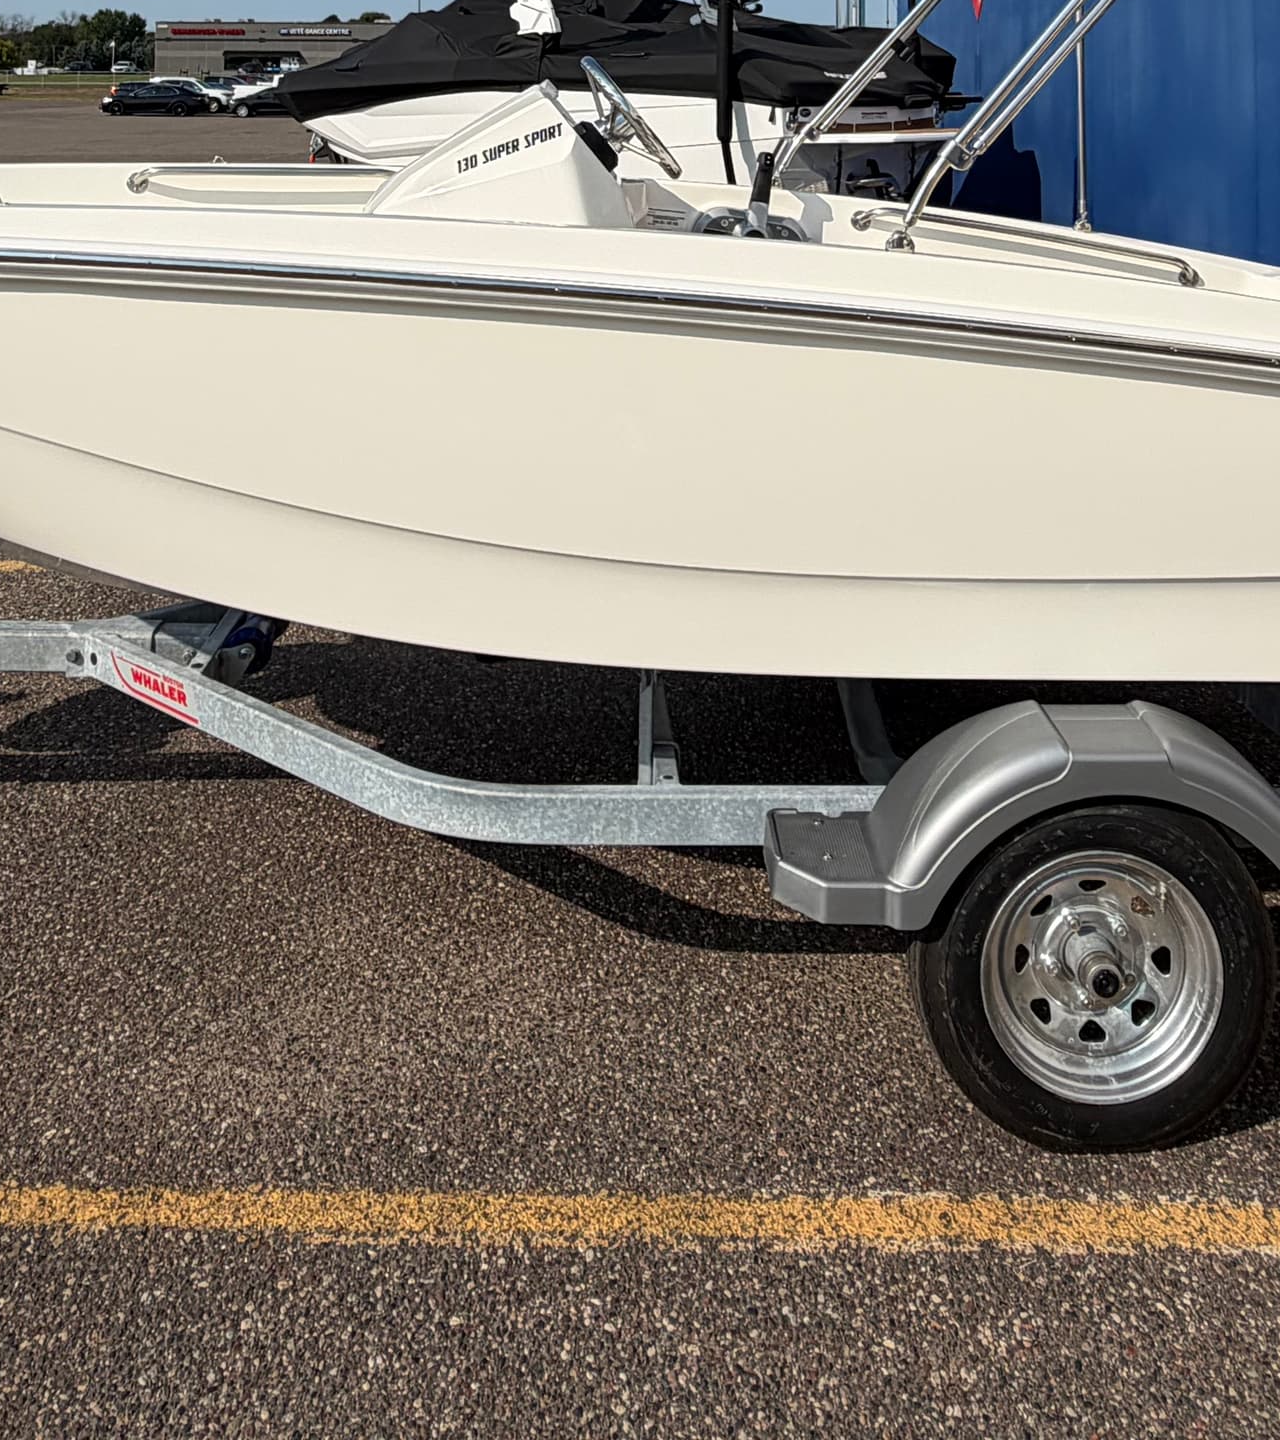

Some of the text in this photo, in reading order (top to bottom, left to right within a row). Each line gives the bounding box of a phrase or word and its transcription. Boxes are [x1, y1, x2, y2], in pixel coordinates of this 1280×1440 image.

[457, 123, 562, 174] 130 SUPER SPORT
[131, 667, 188, 707] WHALER
